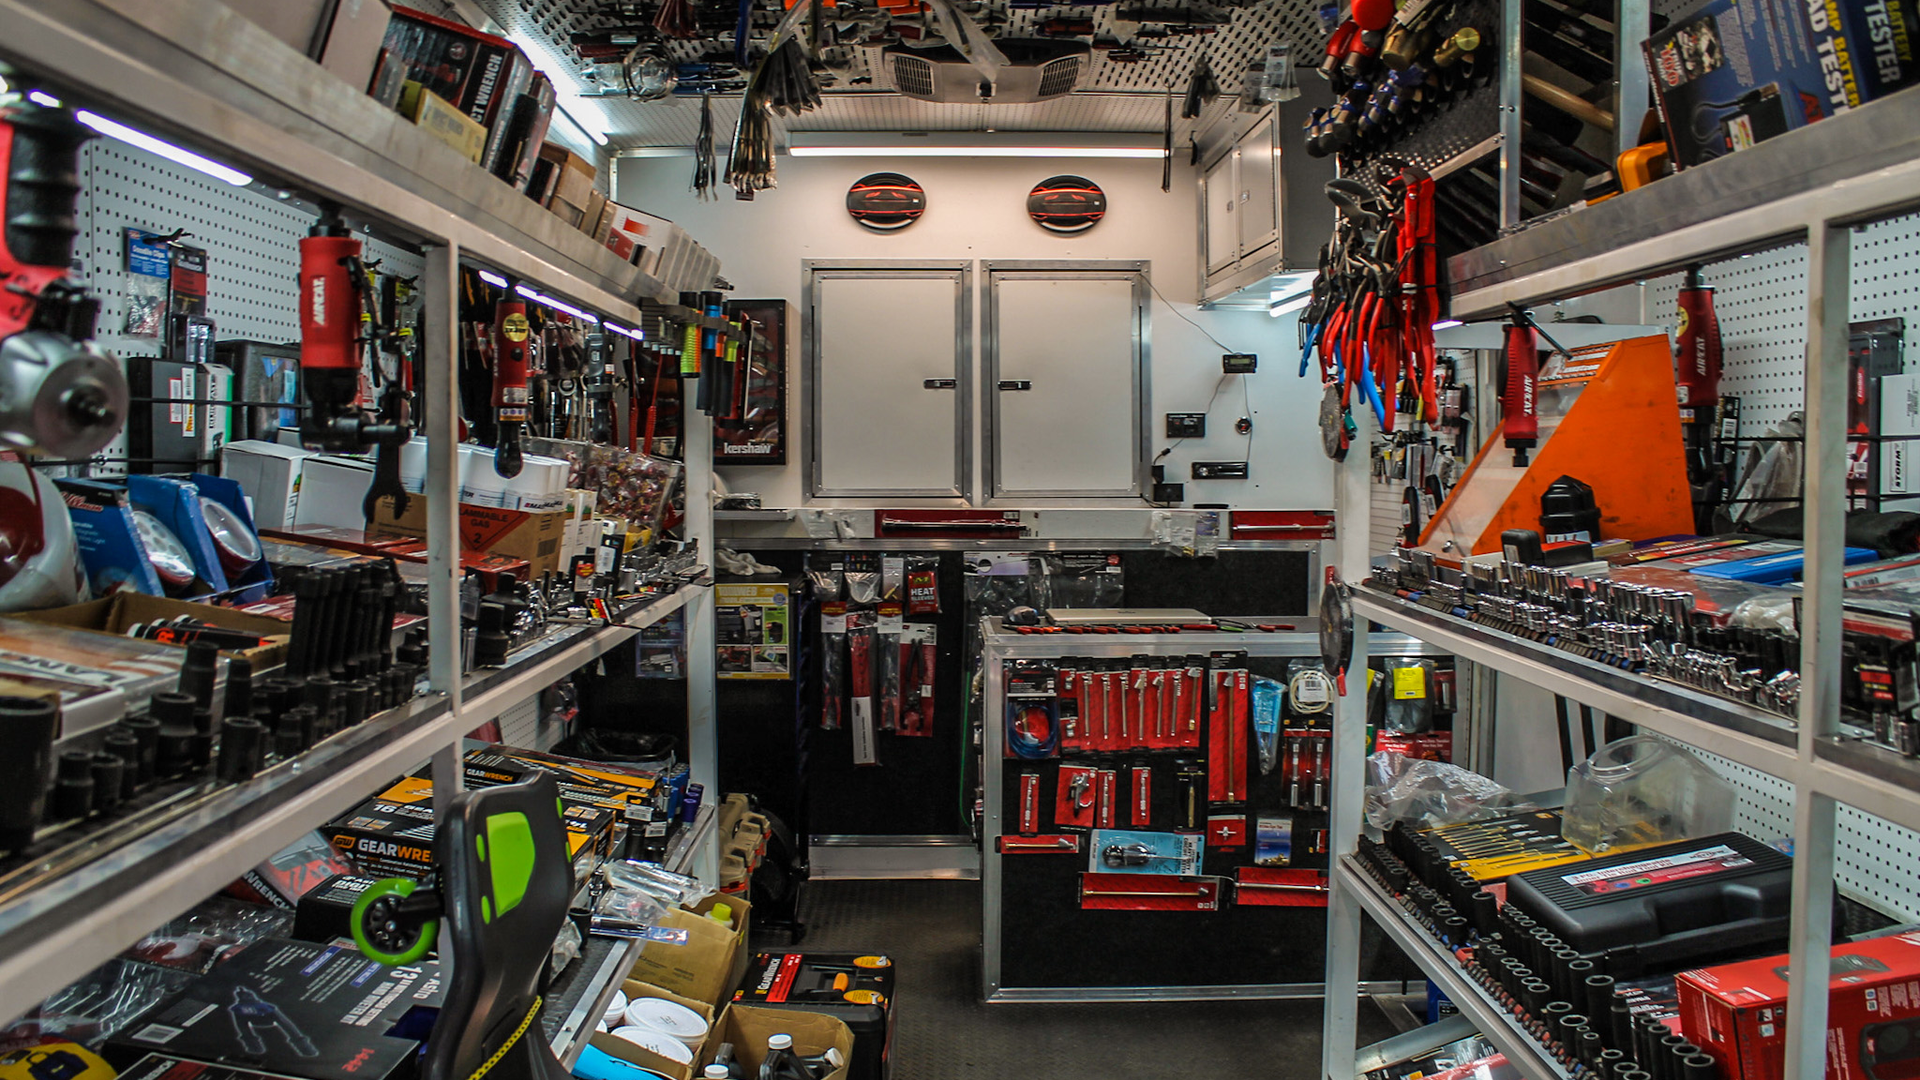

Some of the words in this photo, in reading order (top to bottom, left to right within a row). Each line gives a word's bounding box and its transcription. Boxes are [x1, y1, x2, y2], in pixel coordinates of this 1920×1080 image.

[1808, 0, 1829, 32] AD
[1886, 0, 1912, 60] BATTERY
[1864, 0, 1901, 83] TESTER
[1816, 35, 1850, 116] TEST
[1833, 37, 1860, 107] BATTER
[470, 102, 485, 123] CT
[478, 53, 503, 107] WRENCH
[313, 277, 325, 326] AIRCAT
[1523, 374, 1533, 415] AIRCAT
[724, 442, 771, 454] kershaw
[459, 507, 509, 522] LAMMABLE
[470, 519, 490, 528] GAS
[474, 532, 482, 544] 2
[911, 587, 935, 596] HEAT
[466, 768, 513, 782] GEARWRENCH
[373, 803, 397, 814] 16
[357, 838, 434, 863] GEARWRE
